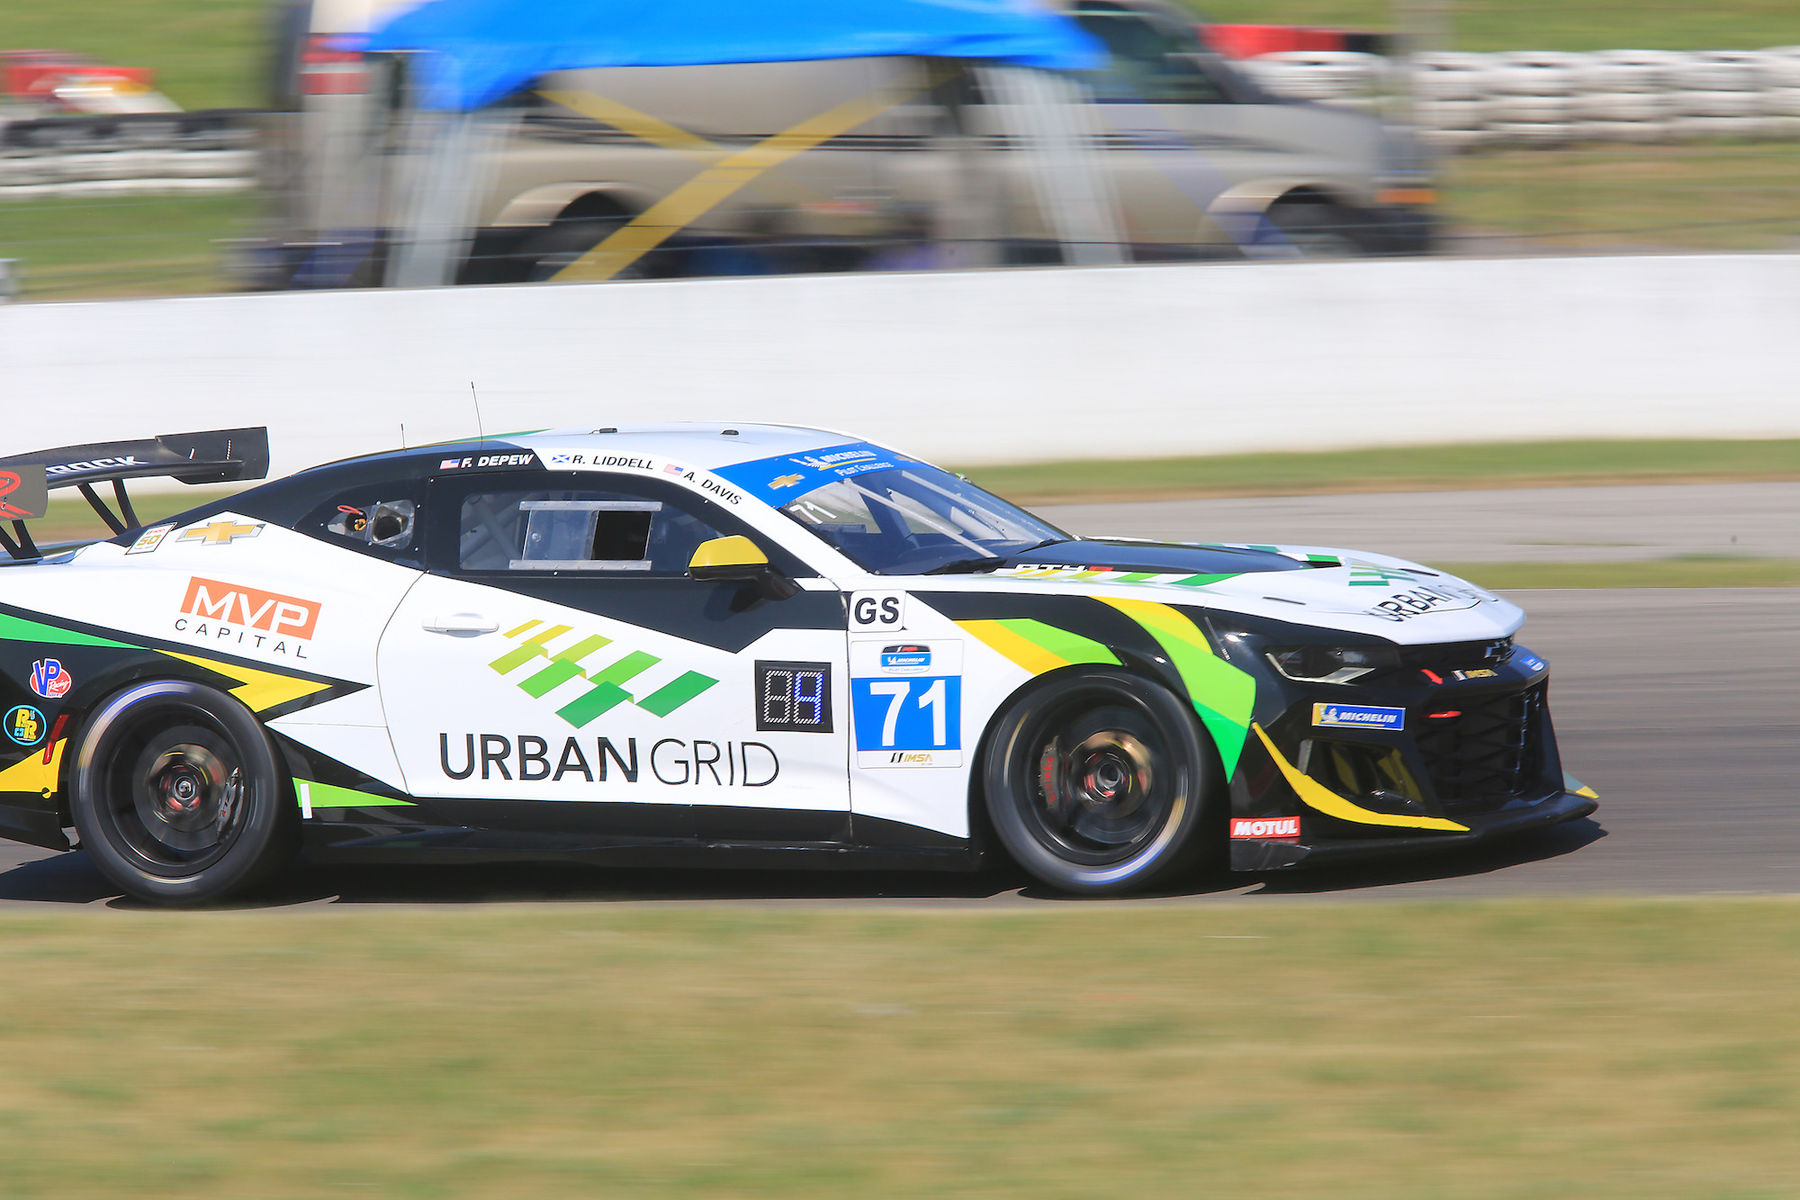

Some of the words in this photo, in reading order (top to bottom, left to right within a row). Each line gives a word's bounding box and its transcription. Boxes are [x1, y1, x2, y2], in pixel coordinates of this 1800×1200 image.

[460, 457, 473, 468] F.
[478, 454, 534, 468] DEPEW
[572, 455, 586, 465] R.
[593, 456, 654, 471] LIDDELL
[682, 471, 696, 483] A.
[700, 479, 742, 506] DAVIS
[789, 500, 838, 525] 71
[190, 585, 309, 634] MVP
[854, 597, 900, 625] GS
[174, 618, 307, 659] CAPITAL
[33, 659, 61, 696] VP
[870, 680, 947, 747] 71
[1339, 711, 1398, 723] MICHELIN
[440, 733, 639, 783] URBAN
[651, 738, 780, 788] GRID
[1233, 820, 1298, 836] MOTUL
